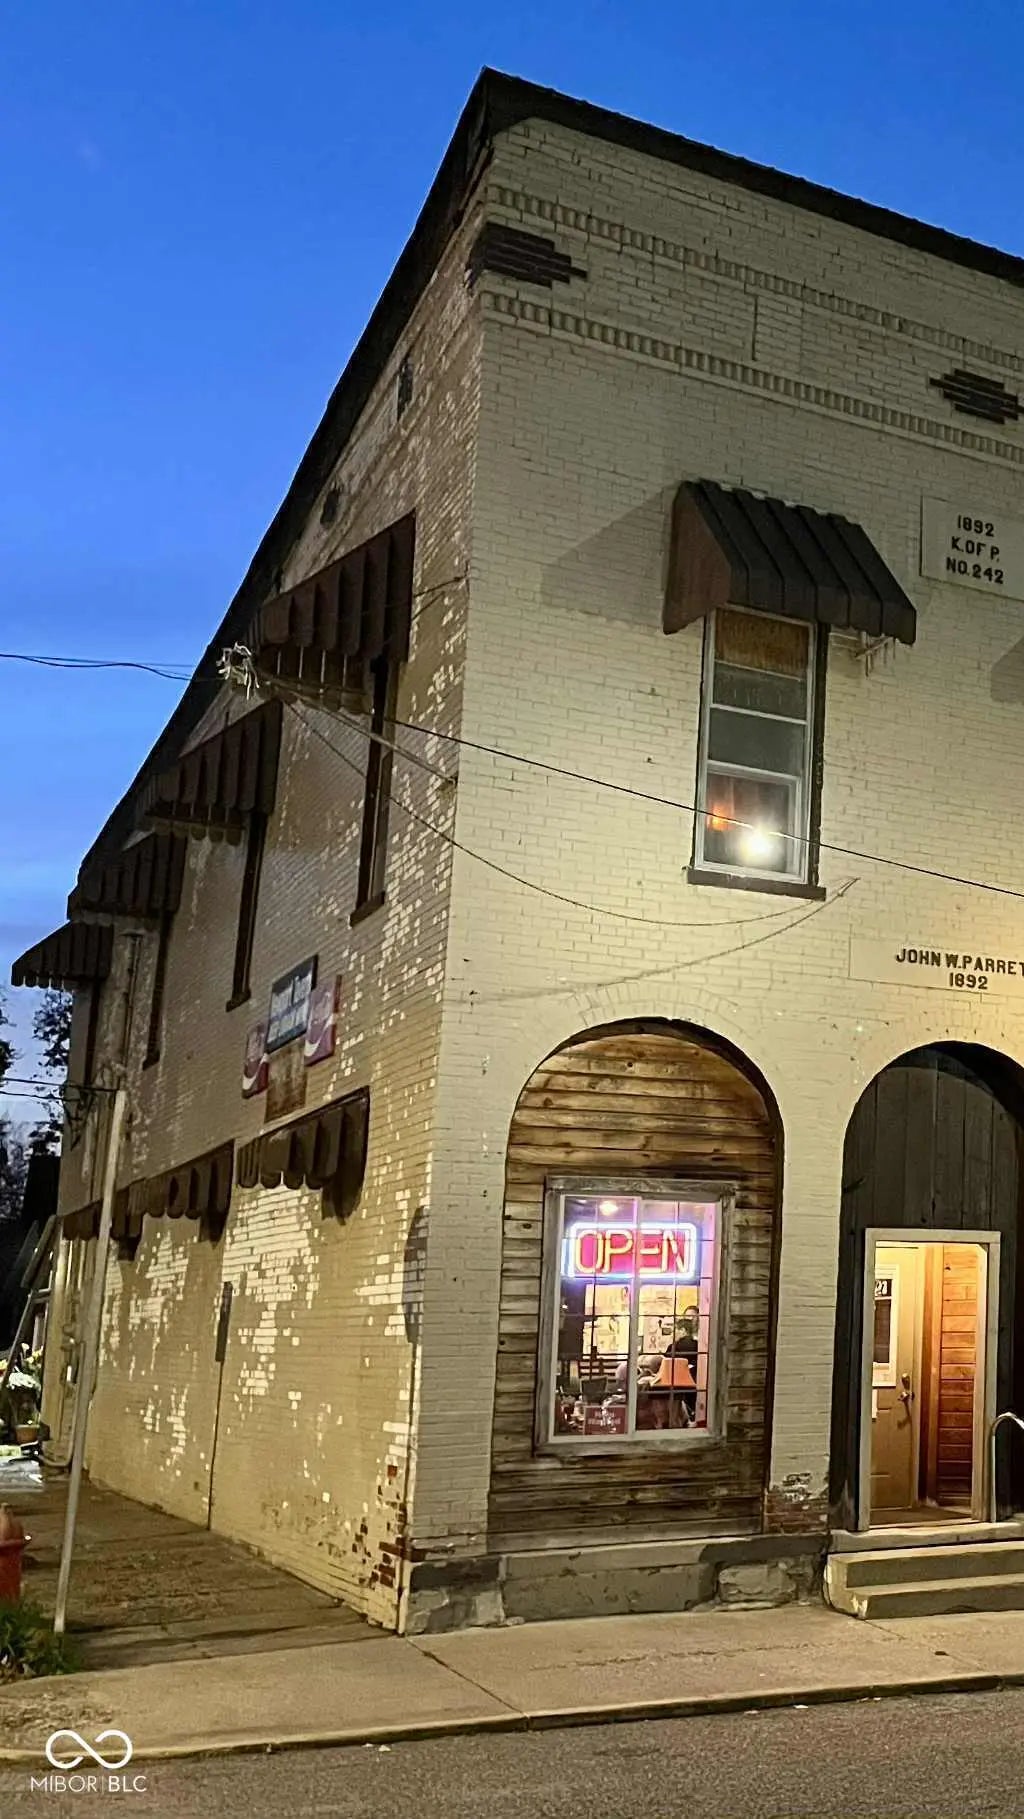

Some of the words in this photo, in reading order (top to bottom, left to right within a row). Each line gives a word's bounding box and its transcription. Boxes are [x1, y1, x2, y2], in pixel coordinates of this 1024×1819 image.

[957, 514, 995, 538] 1892
[896, 948, 941, 967] JOHN
[949, 972, 988, 990] 1892
[575, 1228, 689, 1274] OPEN
